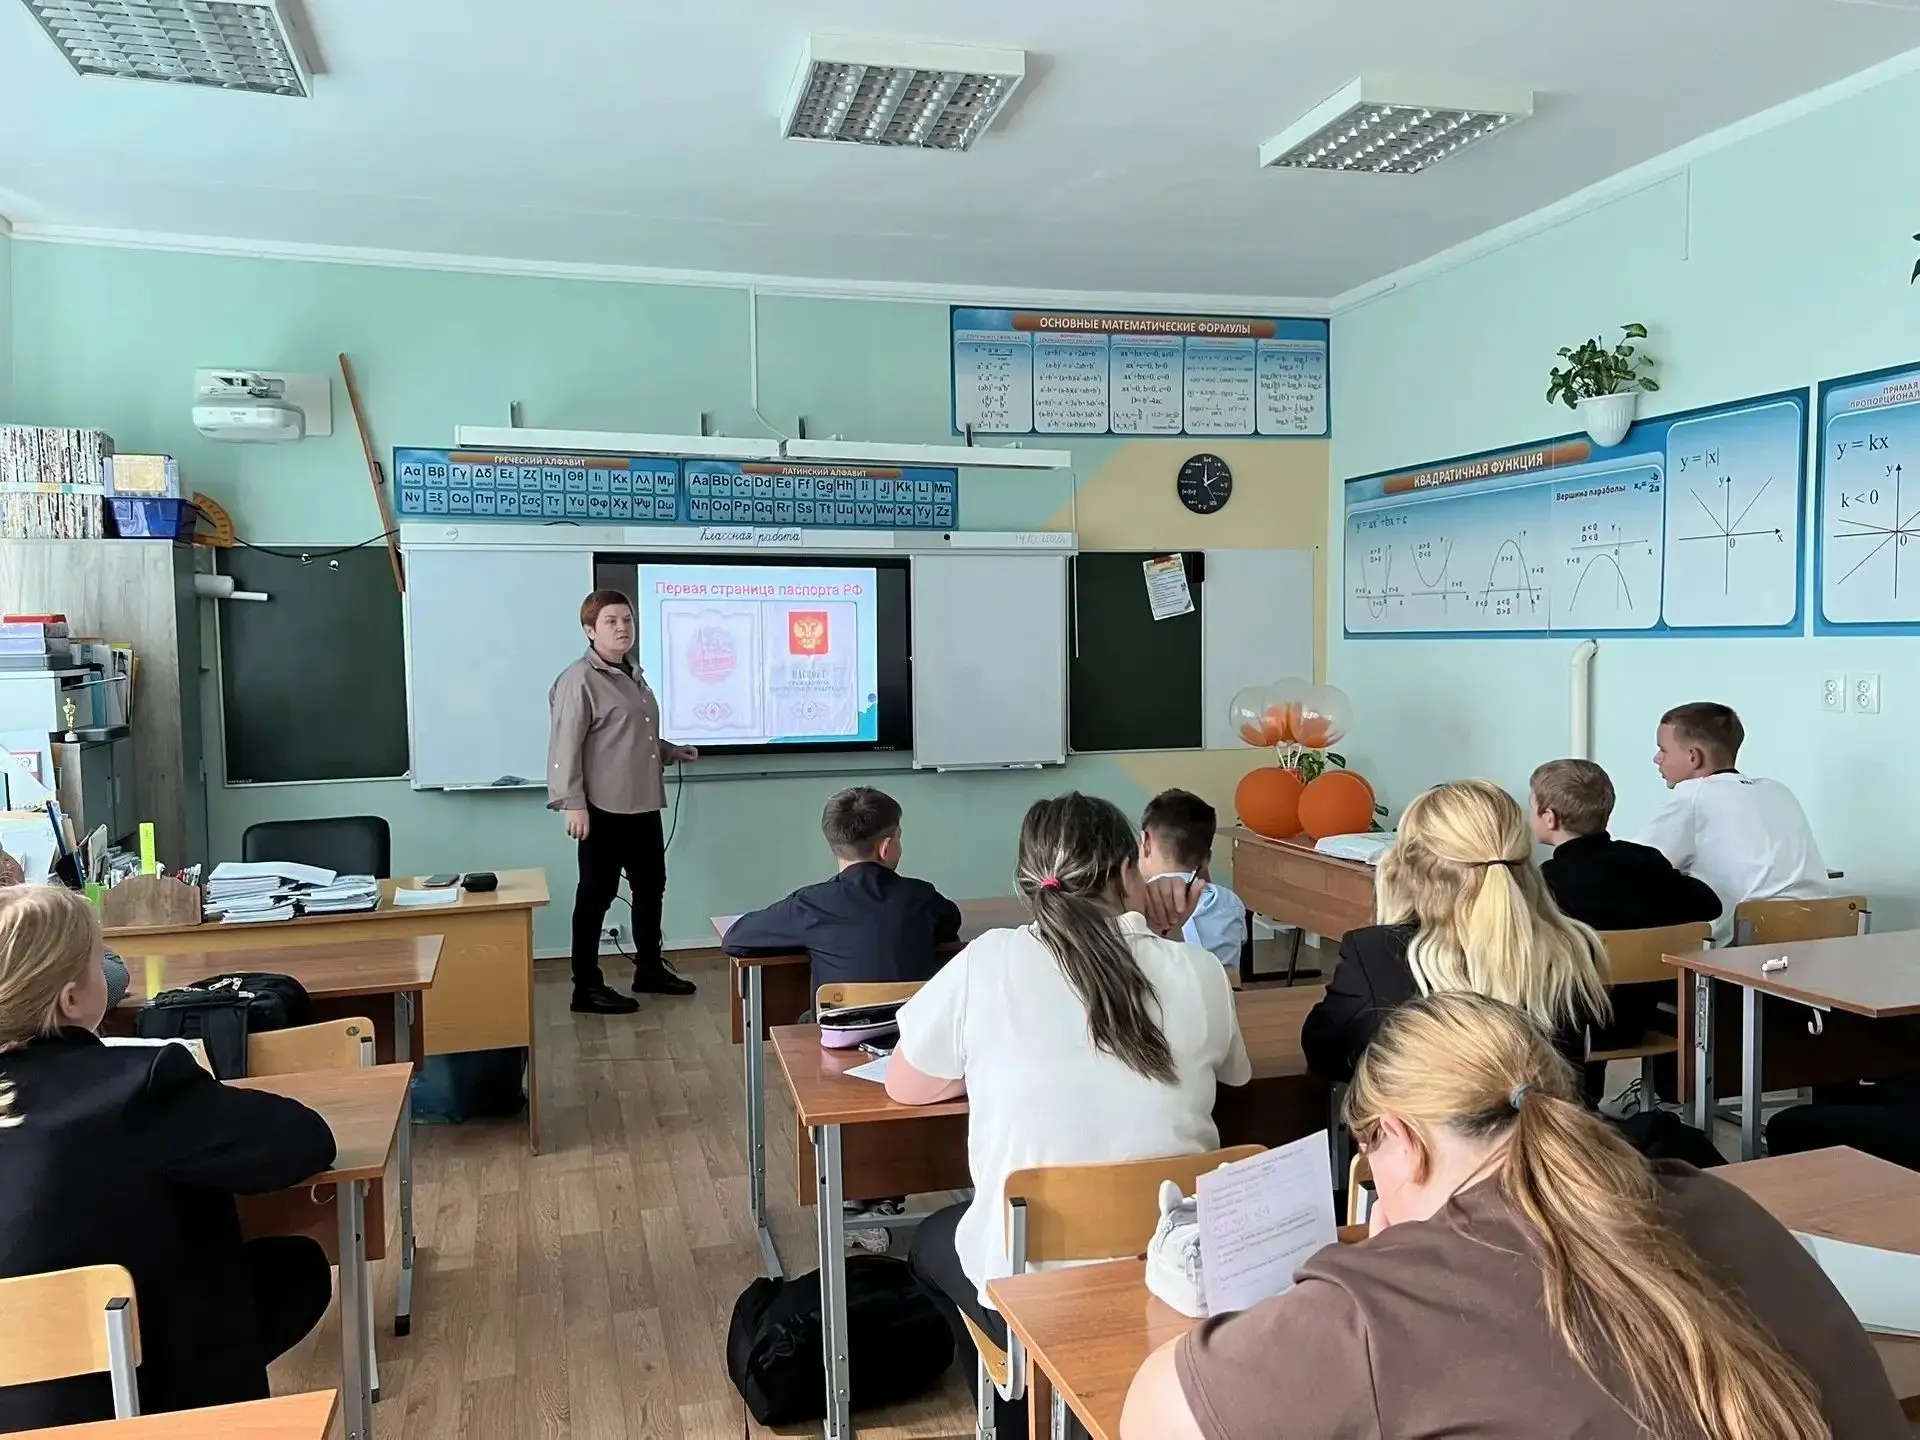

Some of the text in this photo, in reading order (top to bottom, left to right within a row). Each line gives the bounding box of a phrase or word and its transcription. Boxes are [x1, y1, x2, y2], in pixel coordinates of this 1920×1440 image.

[1040, 317, 1251, 334] ОСНОВНЫЕ МАТЕМАТИЧЕСКИЕ ФОРМУЛЫ
[1837, 442, 1848, 460] y
[1868, 433, 1889, 451] kx
[494, 455, 586, 466] ГРЕЧЕСКИЙ АЛФАВИТ
[1414, 452, 1543, 488] КВАДРАТИЧНАЯ ФУНКЦИЯ
[1680, 456, 1689, 472] y
[782, 467, 866, 477] ЛАТИНСКИЙ АЛФАВИТ
[692, 475, 951, 494] Aa Bb Cc Dd Ee Ff Gg Hh Ii Jj Kk Ll Mm
[1841, 492, 1850, 508] k
[1869, 489, 1879, 505] 0
[692, 500, 949, 519] Nn Oo Pp Qq Rr Ss Tt Uu Vv Ww Xx Yy Zz
[700, 528, 800, 547] Классная работа
[655, 582, 863, 598] Первая страница паспорта РФ
